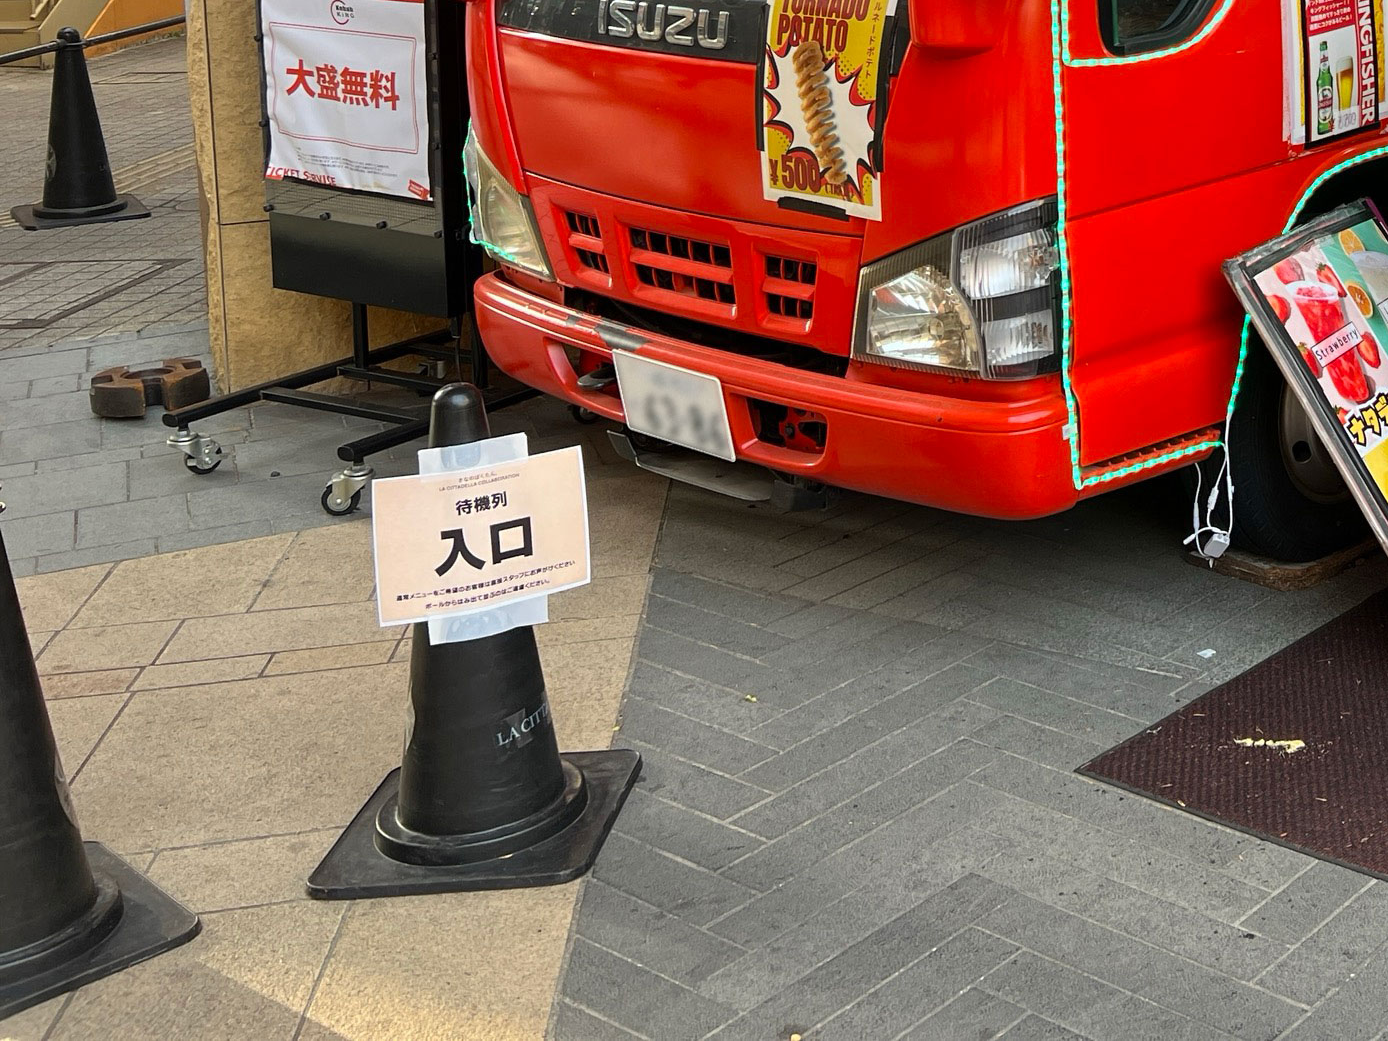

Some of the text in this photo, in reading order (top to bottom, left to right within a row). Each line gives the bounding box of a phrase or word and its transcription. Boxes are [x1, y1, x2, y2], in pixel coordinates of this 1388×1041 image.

[776, 13, 849, 53] POTATO
[285, 58, 400, 111] 大盛無料
[768, 154, 821, 193] ¥500
[1315, 328, 1359, 361] Strawberry
[455, 490, 508, 516] 待機列
[434, 516, 534, 578] 入口
[496, 726, 521, 746] LA
